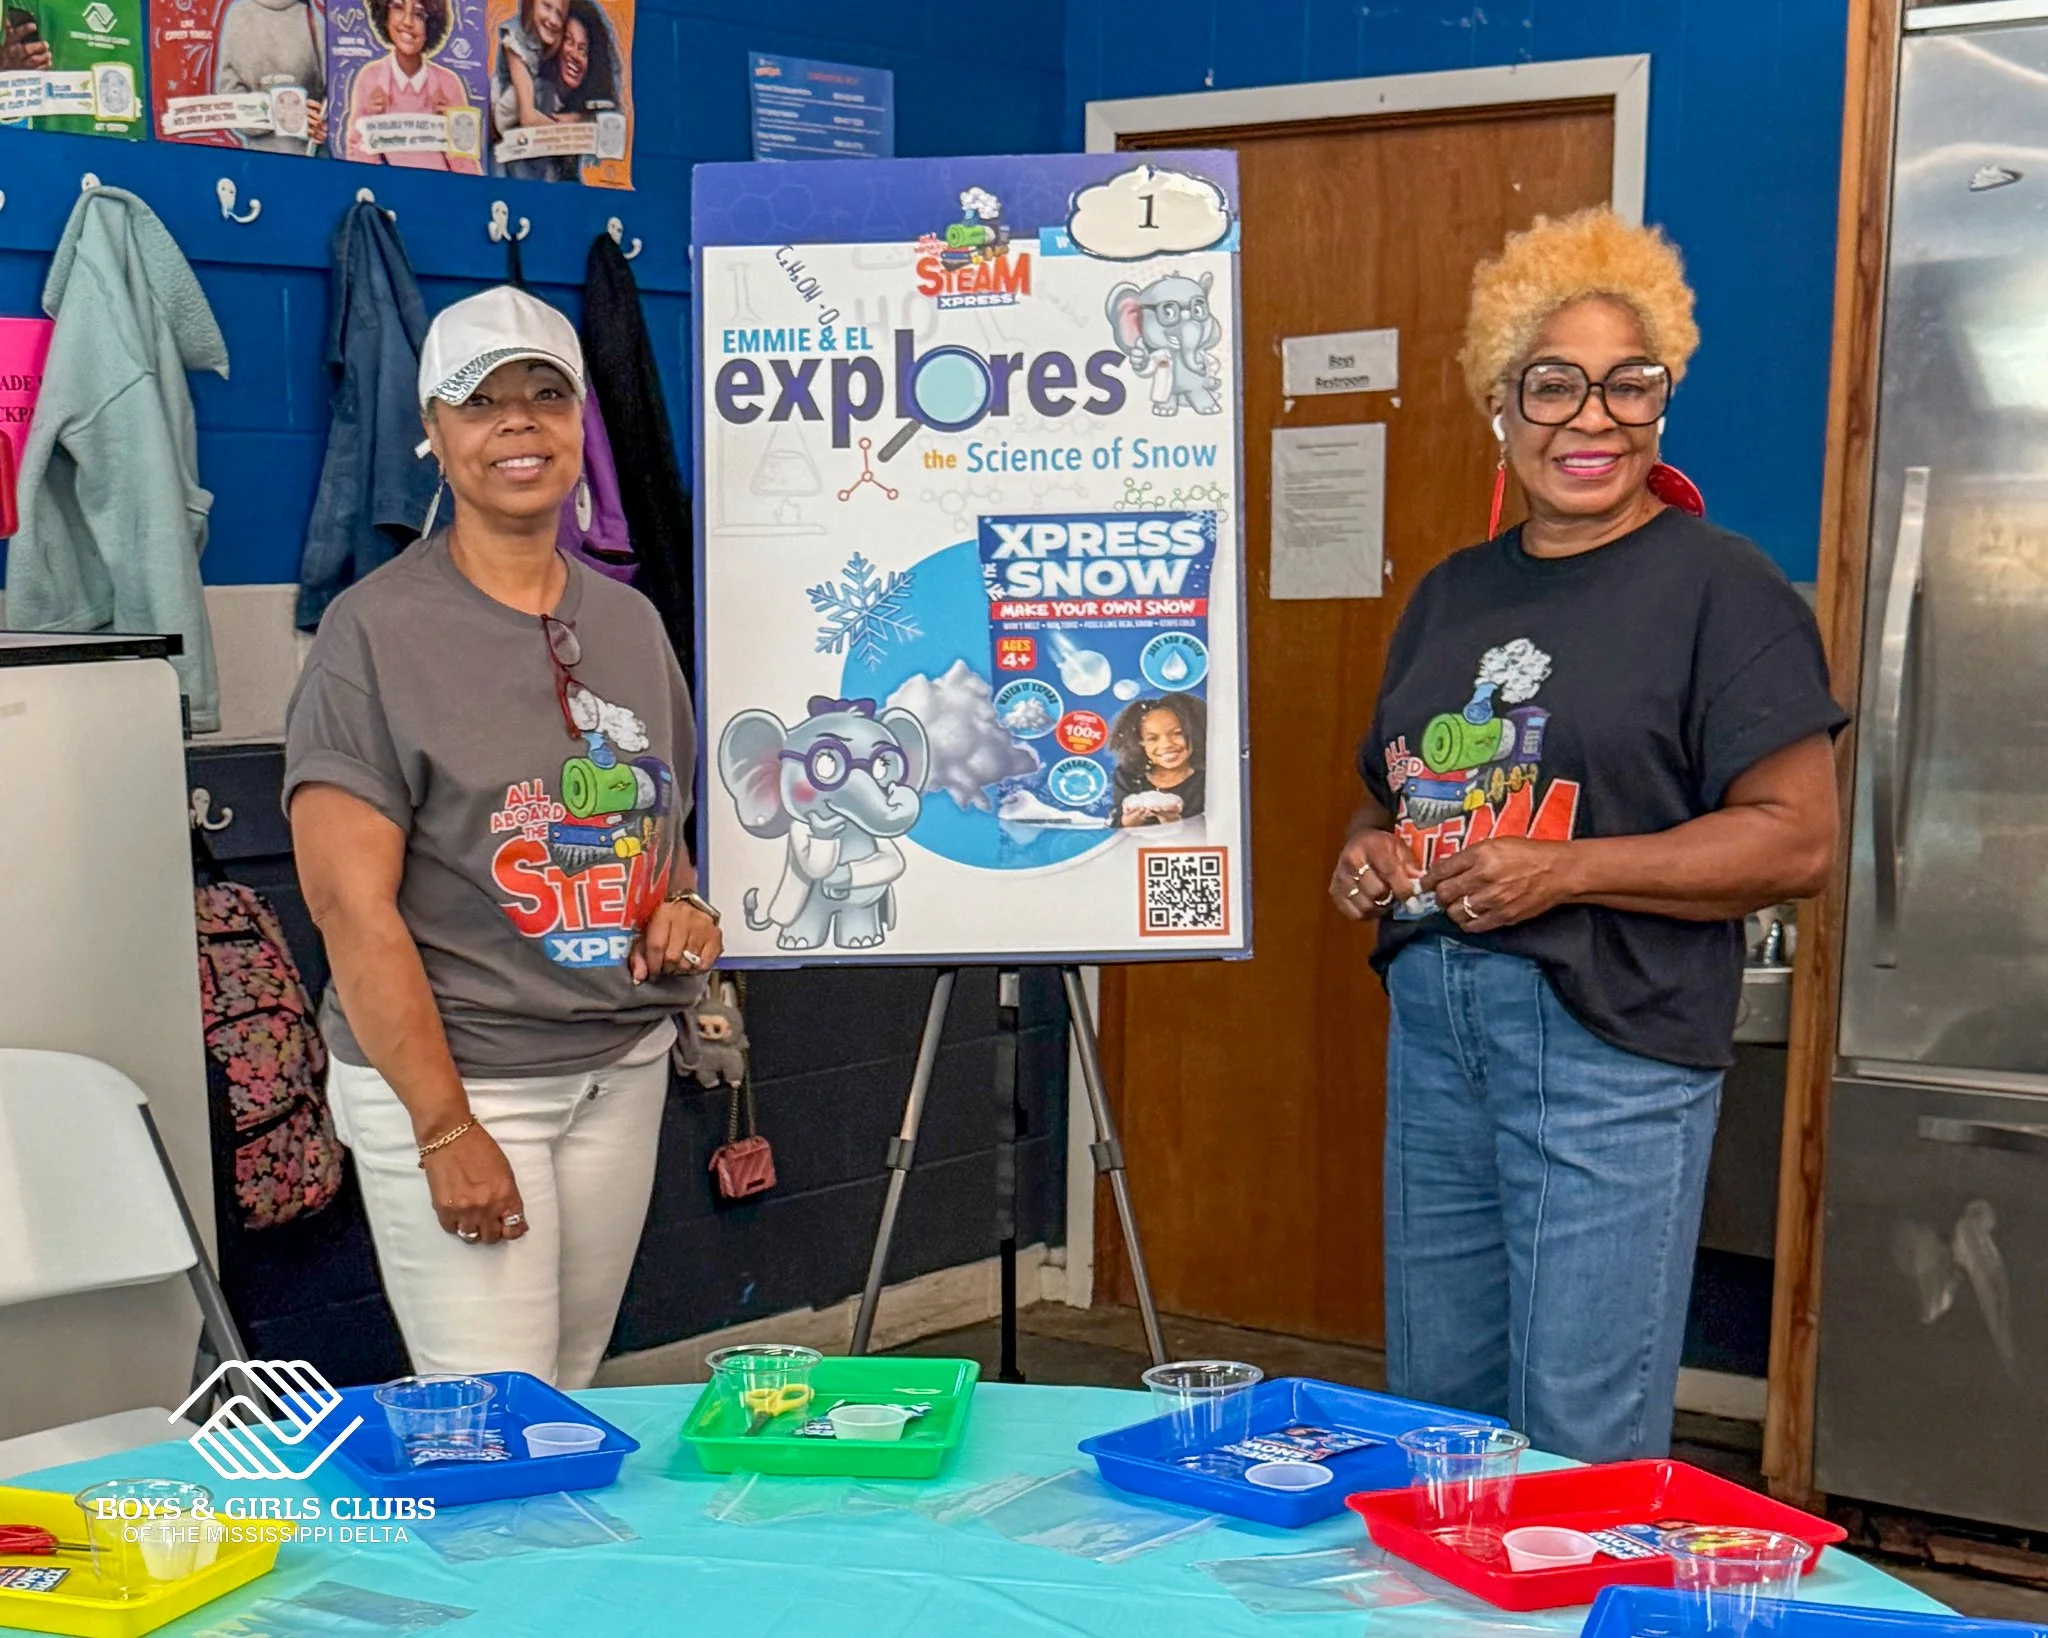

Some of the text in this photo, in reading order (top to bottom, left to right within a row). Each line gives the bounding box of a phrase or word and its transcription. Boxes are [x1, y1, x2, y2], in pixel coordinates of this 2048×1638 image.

[1138, 194, 1159, 229] 1
[916, 253, 1031, 297] STEAM
[939, 292, 1013, 308] XPRESS
[723, 325, 873, 353] EMMIE & EL
[0, 375, 32, 391] ADE
[923, 436, 1218, 474] the Science of Snow
[990, 520, 1205, 559] XPRESS
[1005, 558, 1192, 598] SNOW
[1000, 599, 1196, 618] MAKE YOUR OWN SNOW
[1002, 639, 1032, 652] AGES
[1002, 652, 1031, 667] 4+
[503, 777, 550, 810] ALL
[490, 801, 568, 834] ABOARD
[522, 823, 549, 842] THE
[550, 936, 632, 963] XPR
